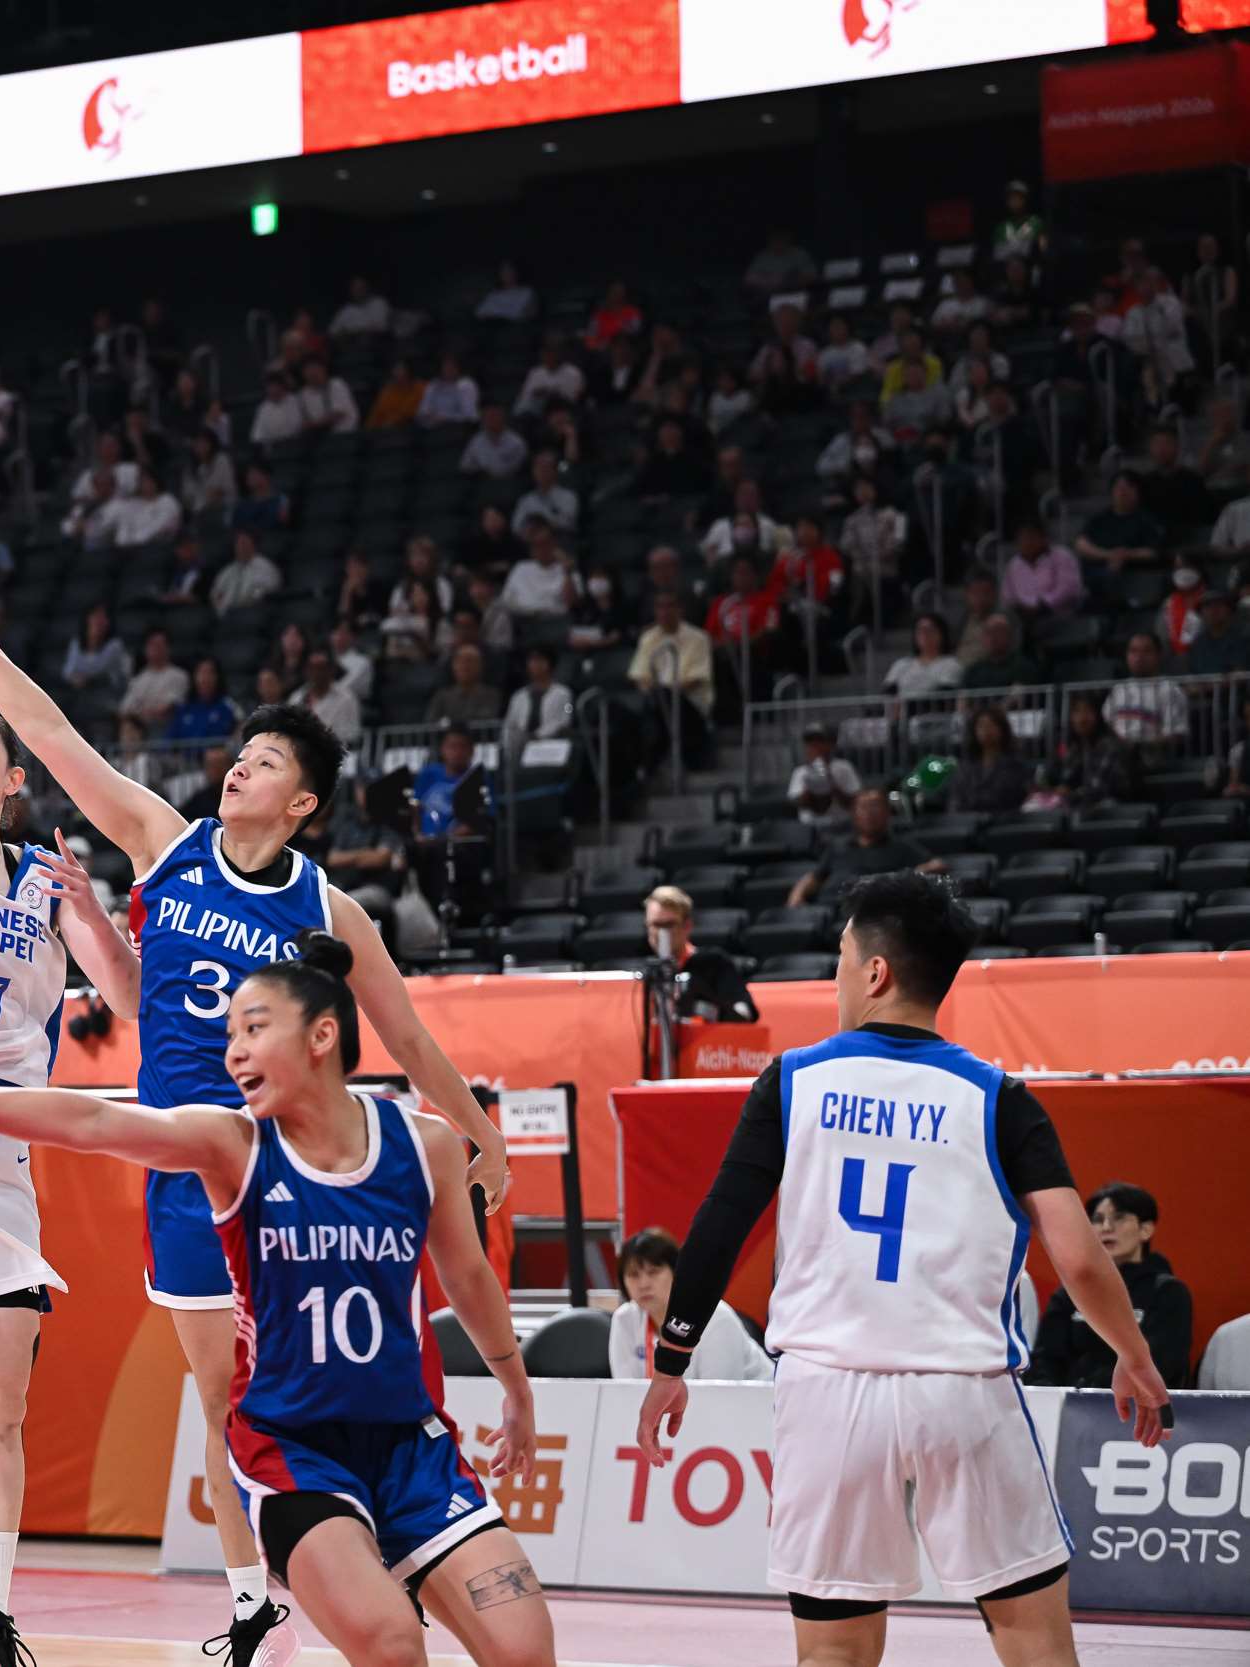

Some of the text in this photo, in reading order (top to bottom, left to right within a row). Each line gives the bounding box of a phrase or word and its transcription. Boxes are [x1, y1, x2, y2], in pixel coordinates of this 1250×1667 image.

[387, 33, 588, 98] Basketball
[157, 897, 299, 963] PILIPINAS
[184, 960, 230, 1019] 3
[820, 1092, 949, 1144] CHEN Y.Y.
[259, 1225, 416, 1262] PILIPINAS
[838, 1157, 917, 1283] 4
[298, 1286, 383, 1364] 10
[669, 1317, 691, 1332] LP
[1081, 1440, 1250, 1518] BO
[1089, 1526, 1241, 1563] SPORTS
